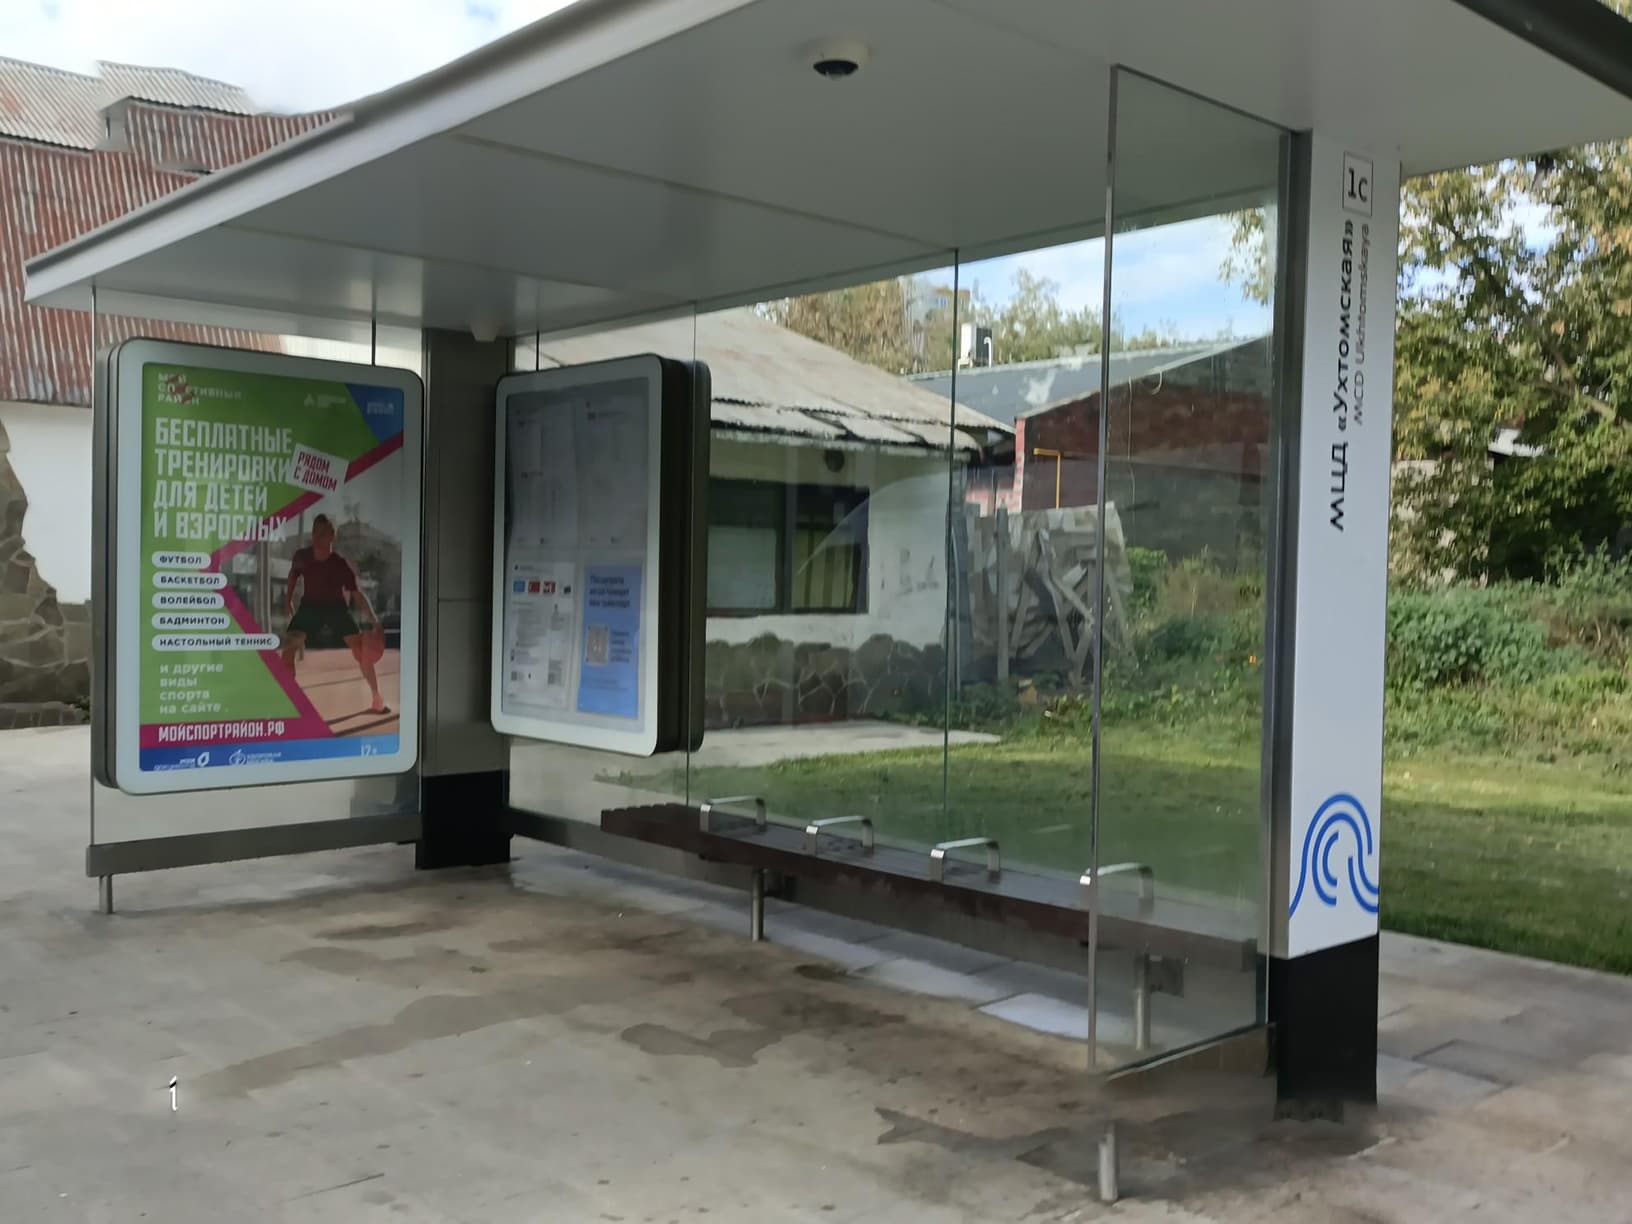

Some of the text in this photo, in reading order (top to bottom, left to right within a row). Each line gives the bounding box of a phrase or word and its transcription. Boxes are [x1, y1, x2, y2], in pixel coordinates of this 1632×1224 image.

[1353, 222, 1371, 427] MCD Ukhtomskaya
[1330, 218, 1354, 533] МЦД «Ухтомская»
[155, 417, 293, 454] БЕСПЛАТНЫЕ
[154, 448, 292, 483] ТРЕНИРОВКИ
[298, 451, 331, 473] РЯДОМ
[294, 469, 338, 492] С ДОМОМ
[153, 479, 268, 513] ДЛЯ ДЕТЕЙ
[154, 511, 288, 543] И ВЗРОСЛЫХ
[159, 555, 203, 566] ФУТБОЛ
[160, 575, 220, 586] БАСКЕТБОЛ
[160, 595, 217, 606] ВОЛЕЙБОЛ
[159, 616, 225, 626] БАДМИНТОН
[159, 637, 272, 647] НАСТОЛЬНЫЙ ТЕННИС
[159, 663, 224, 675] и другие
[159, 678, 198, 688] виды
[159, 690, 210, 702] спорта
[159, 704, 177, 714] на
[158, 721, 285, 743] МОЙСПОРТРАЙОН.РФ
